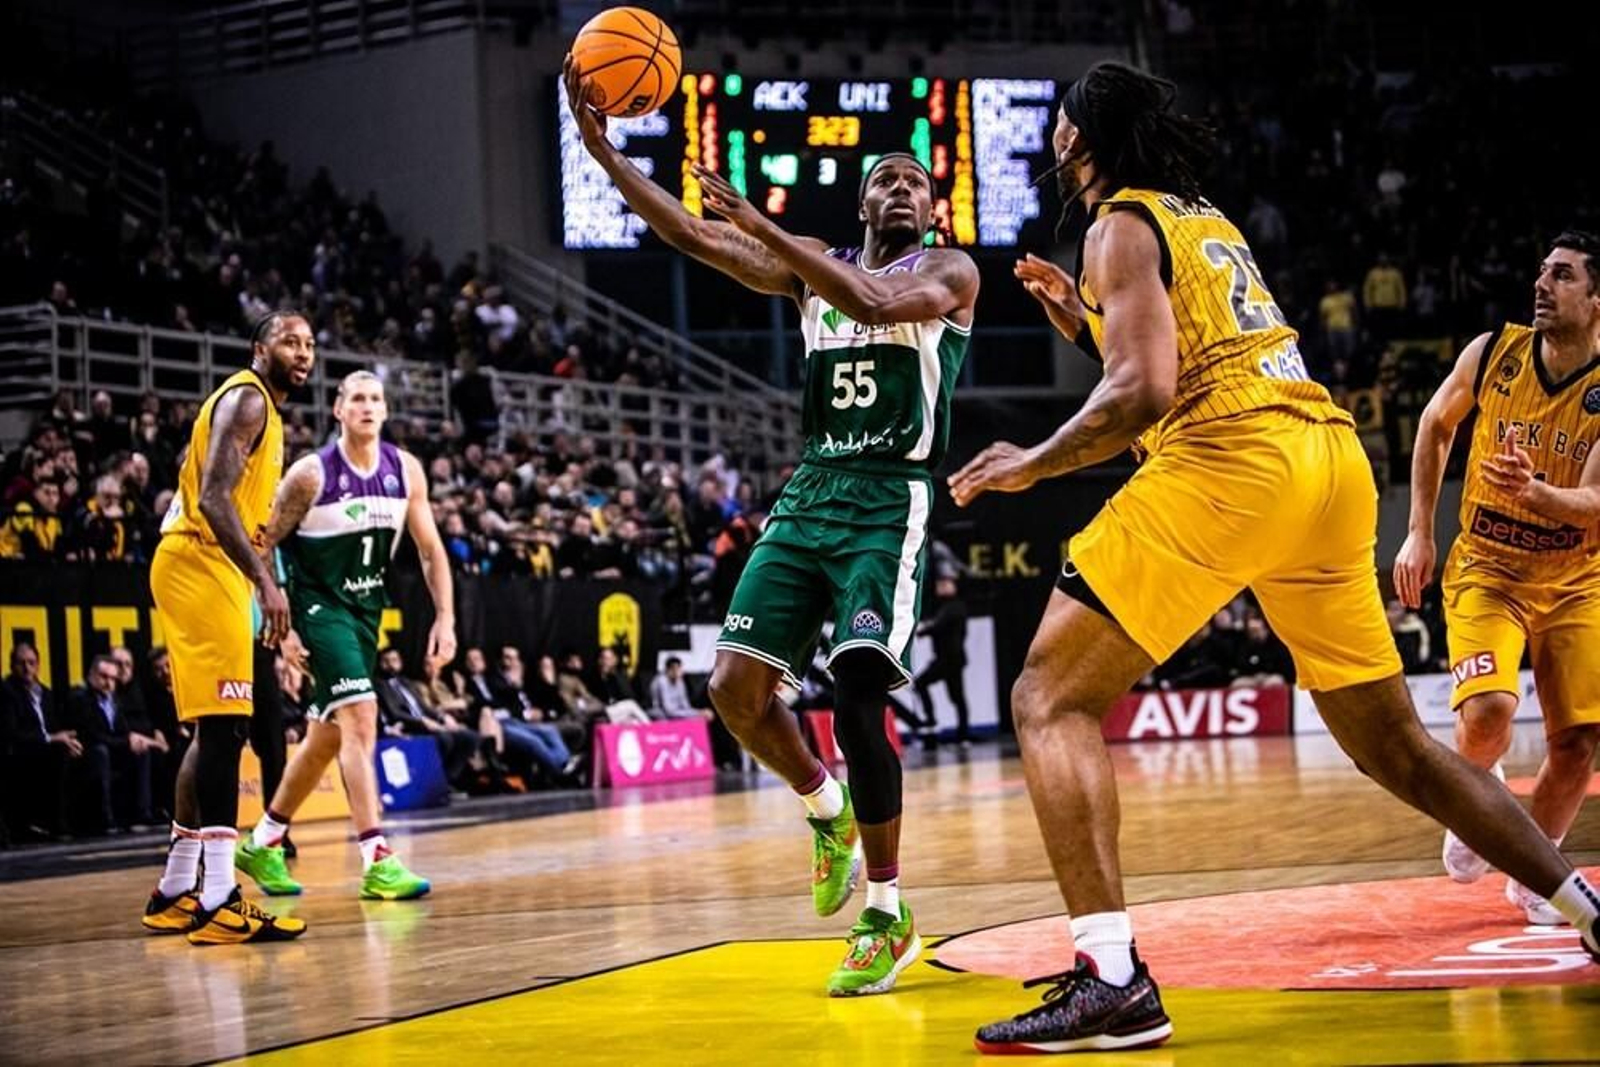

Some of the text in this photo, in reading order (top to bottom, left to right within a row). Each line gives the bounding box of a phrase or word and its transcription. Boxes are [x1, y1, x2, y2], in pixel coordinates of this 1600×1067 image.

[754, 81, 808, 110] AEK
[839, 83, 890, 111] UNI
[818, 158, 837, 185] 3
[831, 360, 878, 410] 55
[361, 536, 374, 566] 1
[1127, 689, 1261, 739] AVIS
